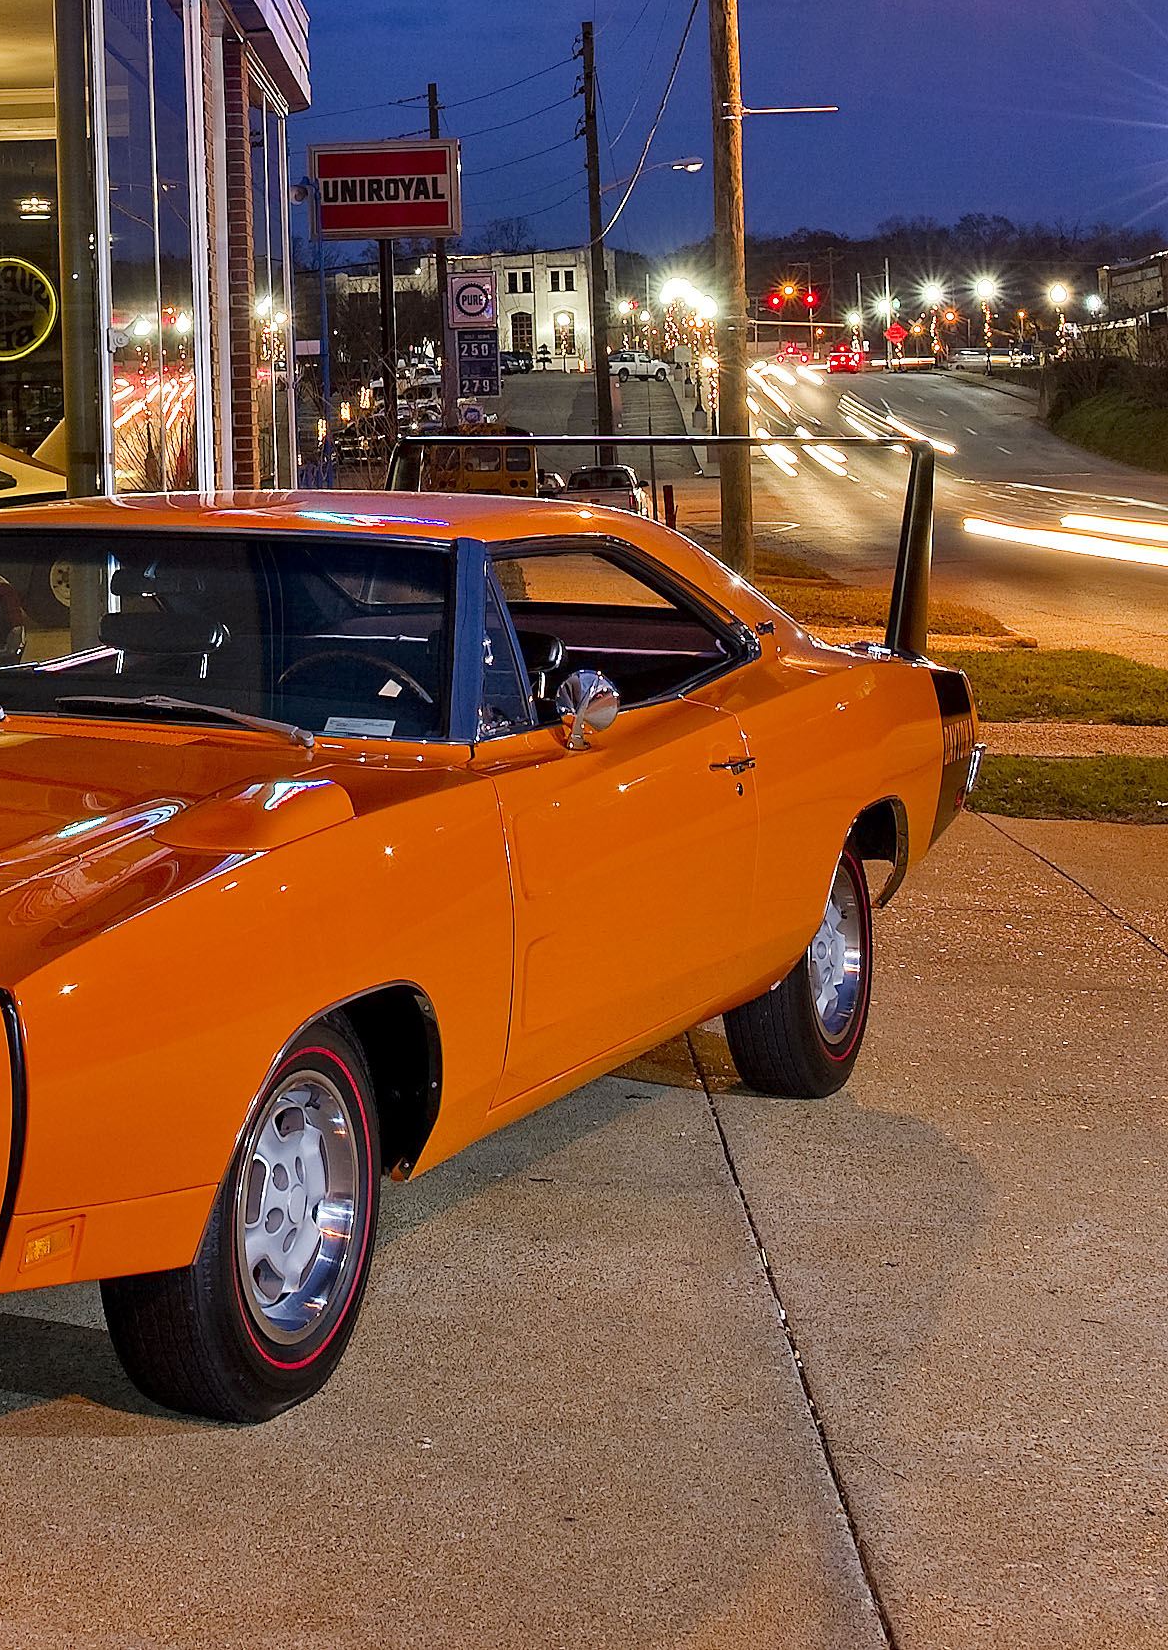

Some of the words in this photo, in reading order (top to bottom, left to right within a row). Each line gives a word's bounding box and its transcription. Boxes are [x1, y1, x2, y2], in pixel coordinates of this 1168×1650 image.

[322, 176, 445, 202] UNIROYAL
[461, 294, 484, 306] PURE
[462, 379, 490, 393] 279
